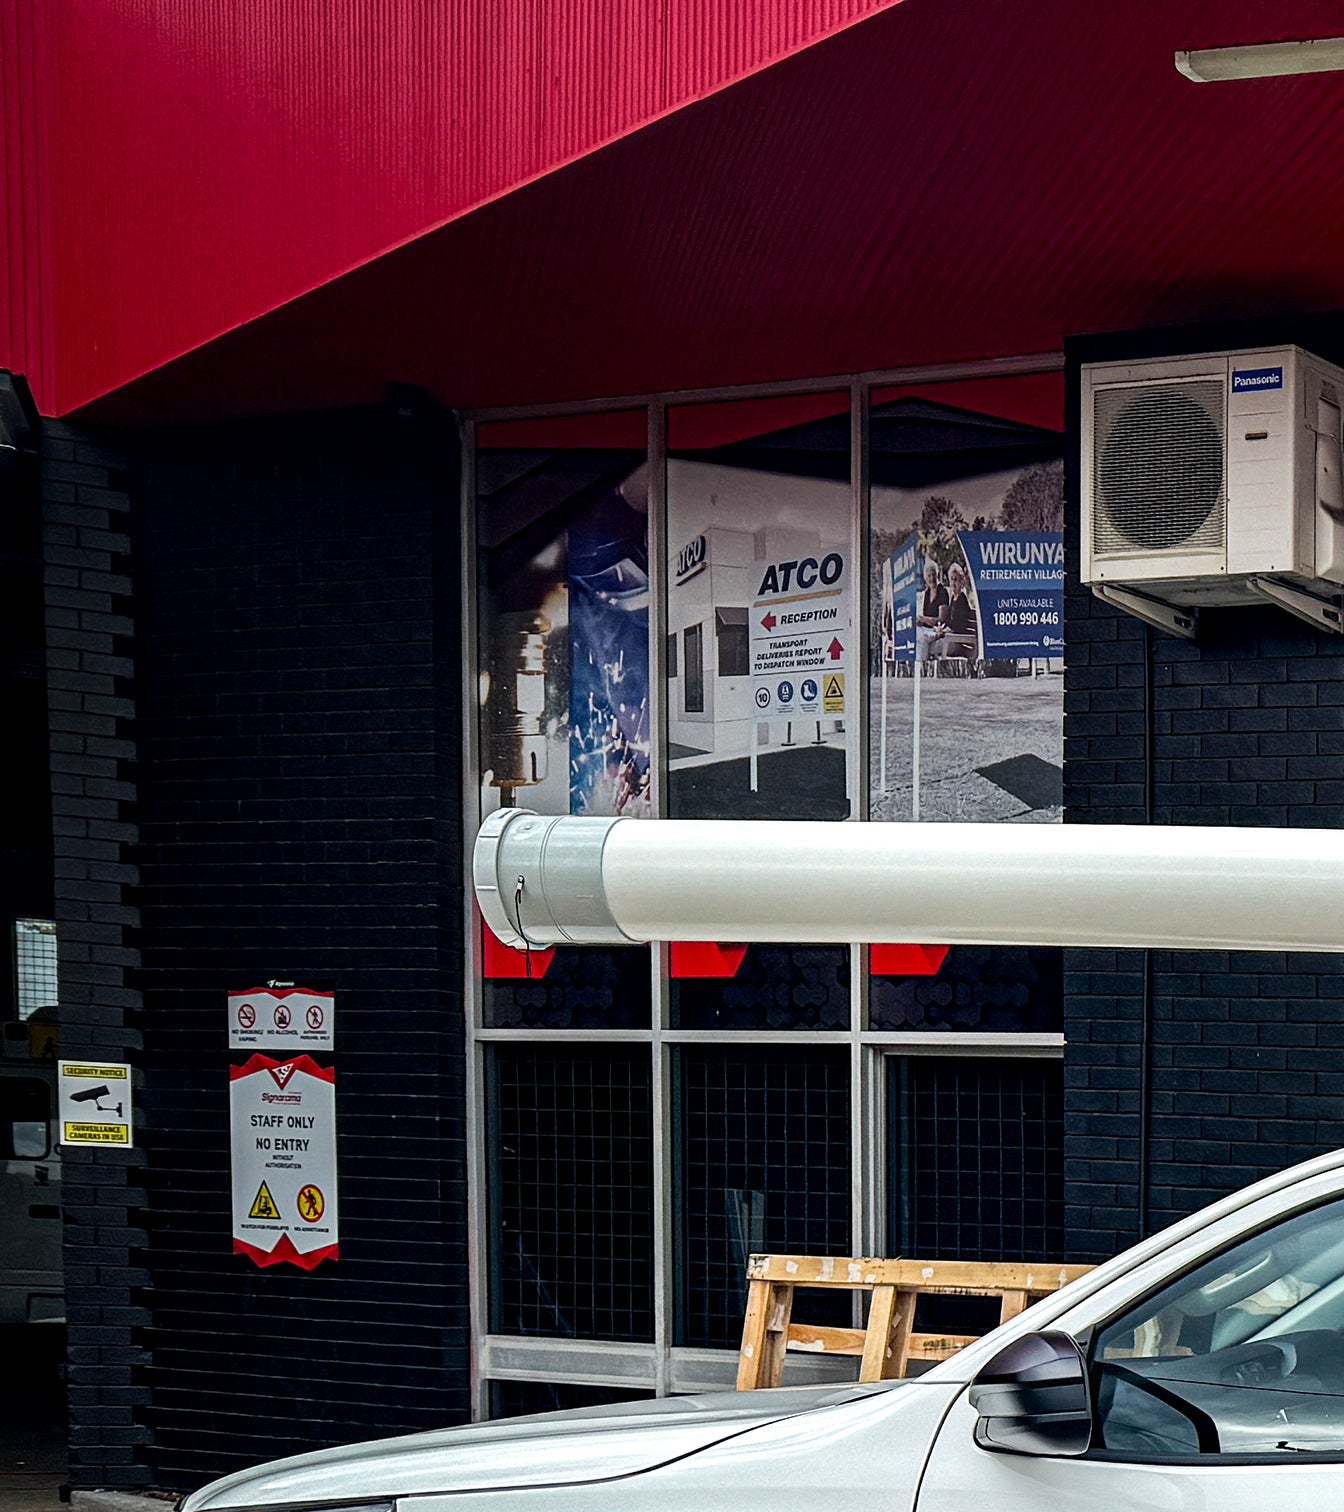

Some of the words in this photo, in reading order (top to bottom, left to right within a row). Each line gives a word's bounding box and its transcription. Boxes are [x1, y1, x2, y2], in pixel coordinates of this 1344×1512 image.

[1234, 373, 1280, 387] Panasonic
[676, 534, 706, 577] ATCO
[979, 542, 1065, 565] WIRUNYA
[757, 552, 844, 596] ATCO
[980, 569, 1033, 580] RETIREMENT
[997, 598, 1019, 608] UNITS
[780, 608, 837, 625] RECEPTION
[993, 612, 1018, 625] 1800
[1019, 612, 1039, 625] 990
[1040, 611, 1059, 625] 446
[769, 639, 808, 649] TRANSPORT
[795, 647, 823, 656] REPORT
[763, 660, 795, 669] DISPATCH
[261, 1092, 302, 1104] Signarama
[250, 1114, 284, 1128] STAFF
[287, 1116, 315, 1129] ONLY
[256, 1138, 271, 1150] NO
[274, 1138, 310, 1151] ENTRY
